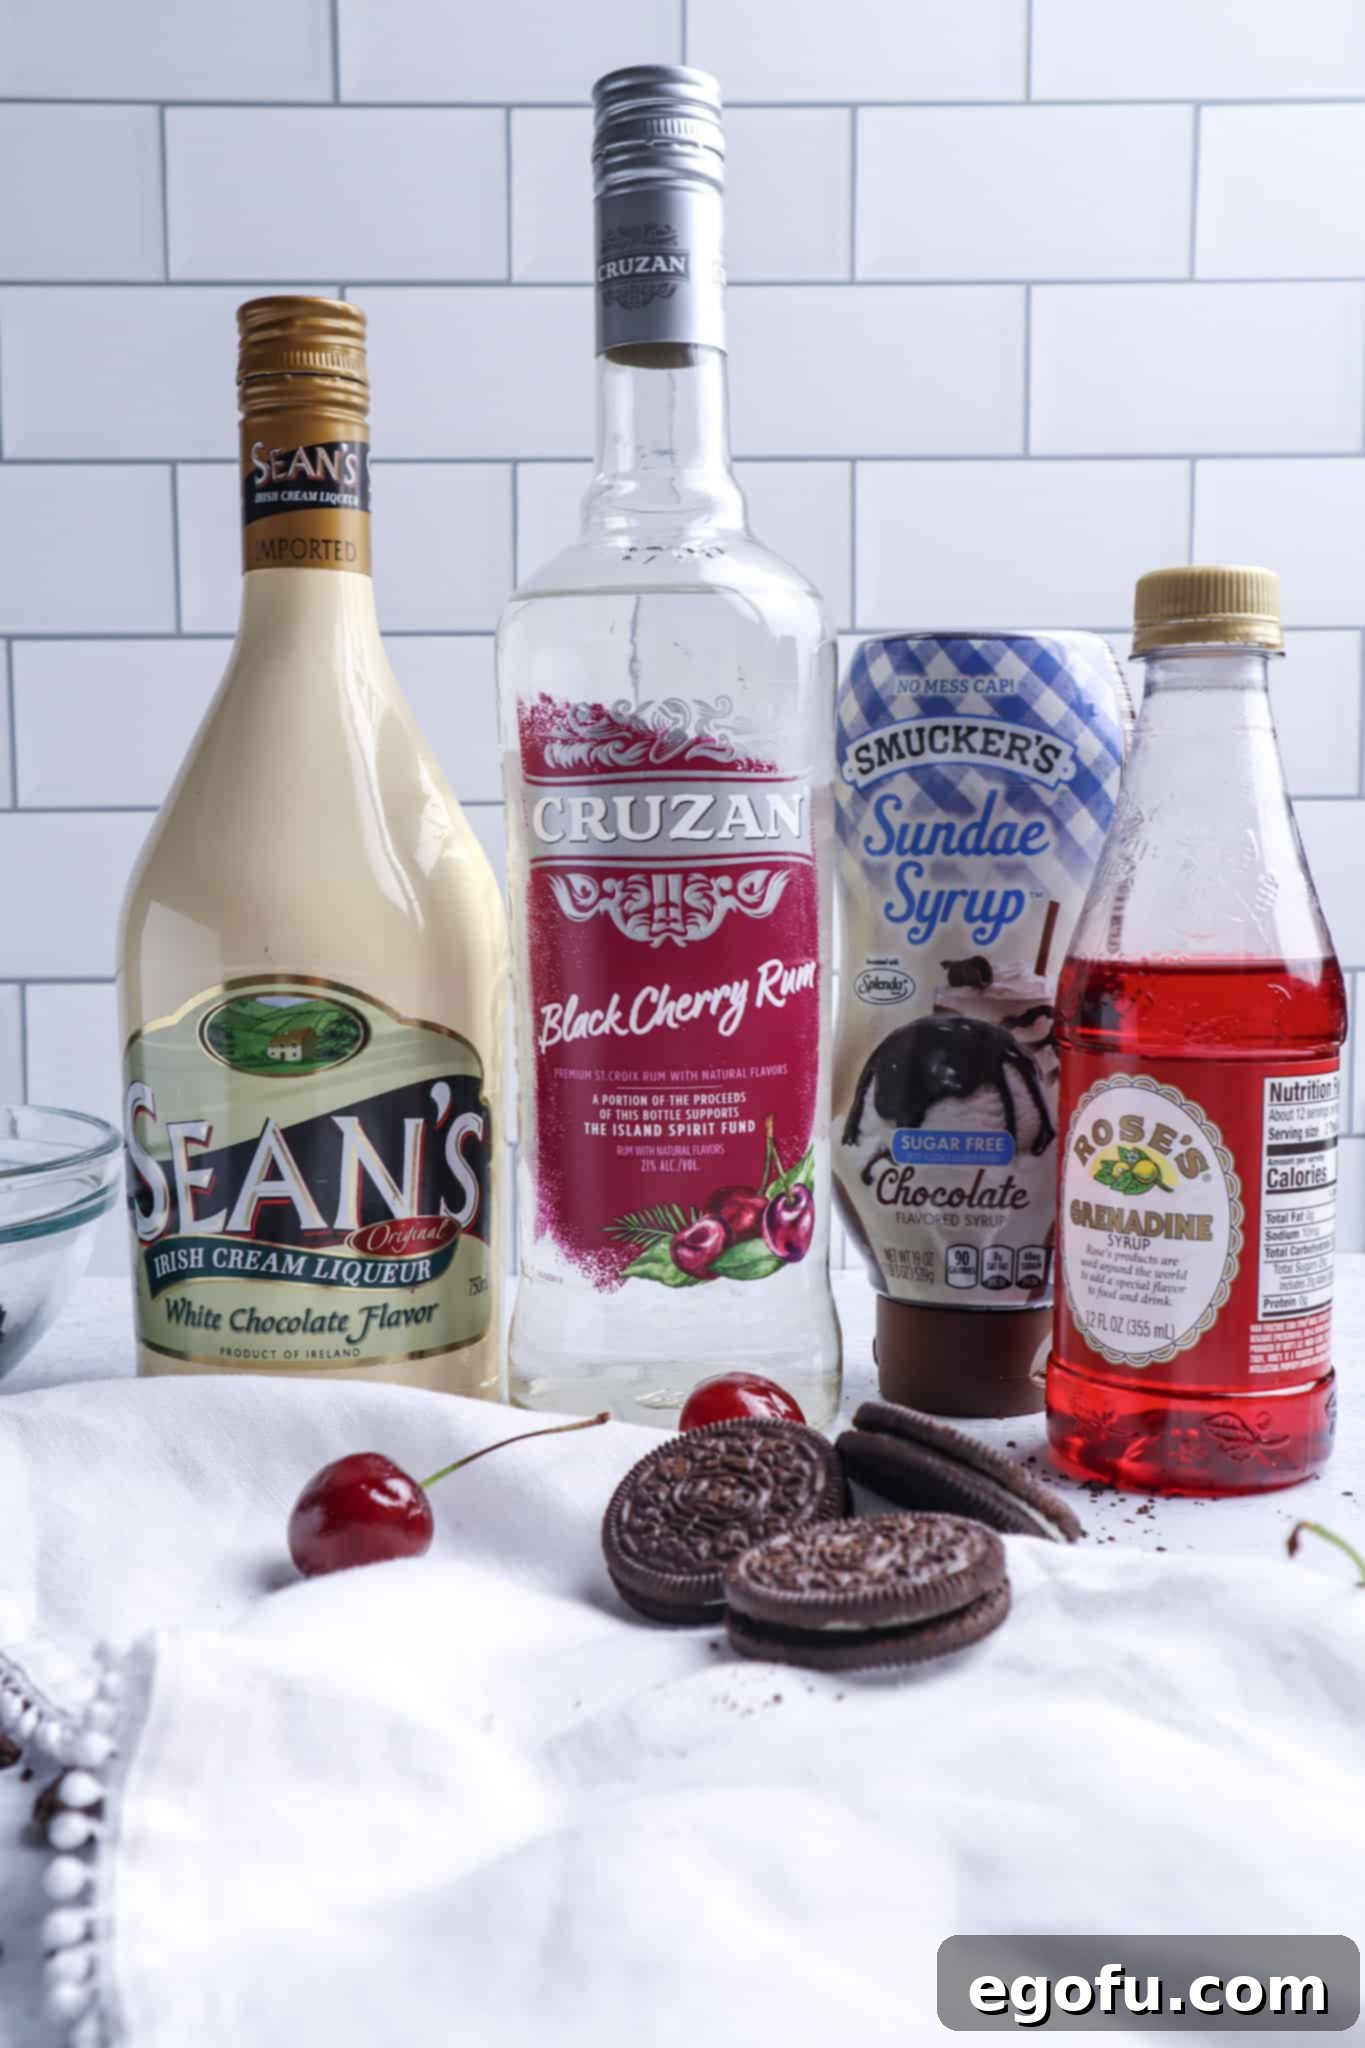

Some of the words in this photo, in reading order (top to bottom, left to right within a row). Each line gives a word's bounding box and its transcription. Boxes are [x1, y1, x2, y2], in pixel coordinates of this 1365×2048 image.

[252, 441, 358, 486] SEAN'S
[281, 490, 317, 502] CREAM
[255, 537, 358, 562] IMPORTED
[898, 678, 921, 694] NO
[924, 678, 969, 694] MESS
[973, 677, 1015, 695] CAP!
[854, 724, 1063, 776] SMUCKER'S
[532, 793, 806, 844] CRUZAN
[863, 788, 1051, 858] Sundae
[884, 860, 1026, 946] Syrup
[539, 993, 629, 1055] Black
[628, 978, 750, 1037] Cherry
[755, 958, 817, 1008] Rum
[554, 1067, 592, 1081] PREMIUM
[642, 1070, 666, 1082] RUM
[670, 1069, 698, 1082] WITH
[702, 1067, 748, 1081] NATURAL
[750, 1063, 789, 1078] FLAVORS
[592, 1093, 599, 1105] A
[602, 1093, 648, 1106] PORTION
[652, 1094, 666, 1106] OF
[669, 1093, 689, 1106] THE
[693, 1091, 747, 1105] PROCEEDS
[1270, 1081, 1332, 1103] Nutrition
[599, 1108, 611, 1120] OF
[615, 1108, 639, 1121] THIS
[642, 1108, 682, 1122] BOTTLE
[685, 1106, 740, 1121] SUPPORTS
[1269, 1108, 1295, 1122] About
[583, 1121, 607, 1136] THE
[612, 1122, 662, 1137] ISLAND
[668, 1121, 715, 1137] SPIRIT
[721, 1119, 756, 1135] FUND
[1268, 1125, 1303, 1142] Serving
[616, 1144, 633, 1156] RUM
[635, 1144, 655, 1156] WITH
[656, 1144, 691, 1156] NATURAL
[692, 1143, 726, 1156] FLAVORS
[902, 1134, 961, 1151] SUGAR
[965, 1136, 1005, 1152] FREE
[1073, 1114, 1210, 1181] ROSE'S
[124, 1080, 484, 1244] SEAN'S
[1266, 1163, 1328, 1190] Calories
[876, 1166, 1031, 1211] Chocolate
[896, 1211, 961, 1227] FLAVORED
[964, 1213, 1008, 1228] SYRUP
[1070, 1198, 1214, 1243] GRENADINE
[1265, 1212, 1288, 1225] Total
[1290, 1210, 1305, 1223] Fat
[366, 1217, 450, 1254] Original
[1107, 1232, 1152, 1252] SYRUP
[1265, 1229, 1300, 1242] Sodium
[953, 1250, 970, 1266] 90
[1114, 1252, 1158, 1265] products
[1160, 1257, 1180, 1267] are
[1265, 1246, 1288, 1259] Total
[154, 1248, 204, 1279] IRISH
[212, 1248, 307, 1276] CREAM
[312, 1258, 433, 1288] LIQUEUR
[1099, 1263, 1134, 1275] around
[1135, 1266, 1153, 1279] the
[1154, 1269, 1189, 1281] world
[1095, 1285, 1118, 1300] food
[1118, 1291, 1140, 1303] and
[1140, 1293, 1174, 1307] drink.
[1106, 1278, 1113, 1286] a
[1115, 1279, 1151, 1292] special
[1150, 1281, 1188, 1295] flavor
[1263, 1296, 1297, 1310] Protein
[164, 1296, 223, 1331] White
[229, 1307, 350, 1337] Chocolate
[345, 1301, 440, 1345] Flavor
[1097, 1312, 1108, 1332] FL
[1110, 1315, 1125, 1335] OZ
[1126, 1317, 1152, 1338] (355
[1153, 1322, 1176, 1341] mL)
[219, 1346, 278, 1360] PRODUCT
[284, 1348, 300, 1360] OF
[306, 1346, 361, 1360] IRELAND
